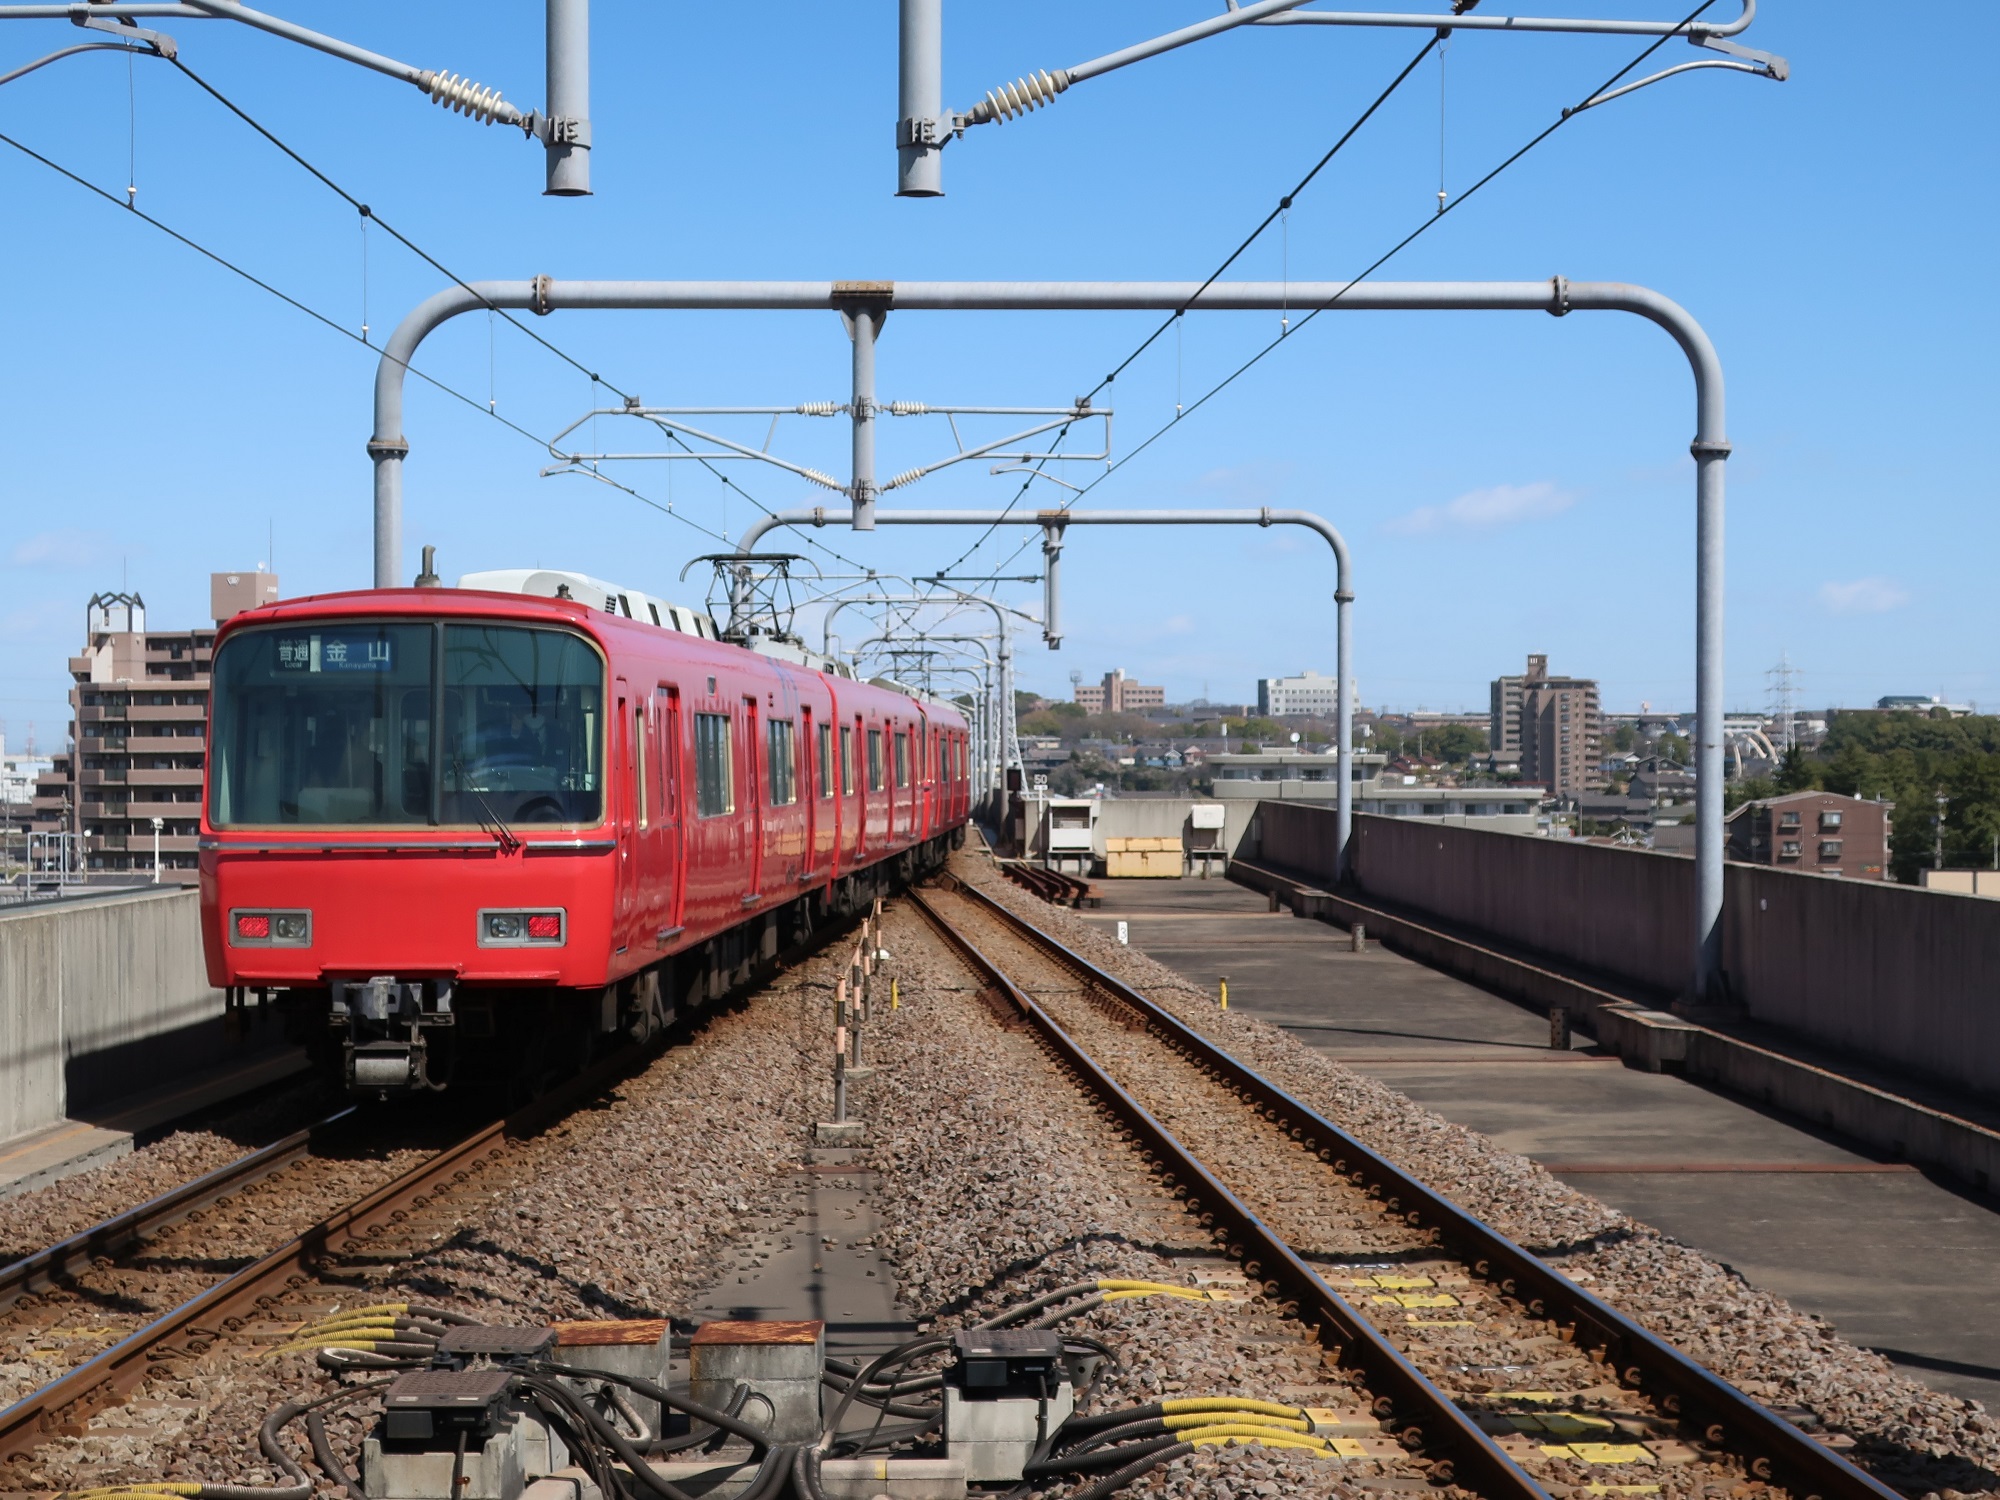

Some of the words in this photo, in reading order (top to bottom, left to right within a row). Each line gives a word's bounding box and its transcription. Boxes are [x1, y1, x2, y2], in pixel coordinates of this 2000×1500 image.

[279, 640, 308, 662] 普通
[326, 640, 389, 662] 金山
[284, 661, 303, 669] Local
[1034, 774, 1048, 785] 50
[1120, 927, 1127, 939] 3
